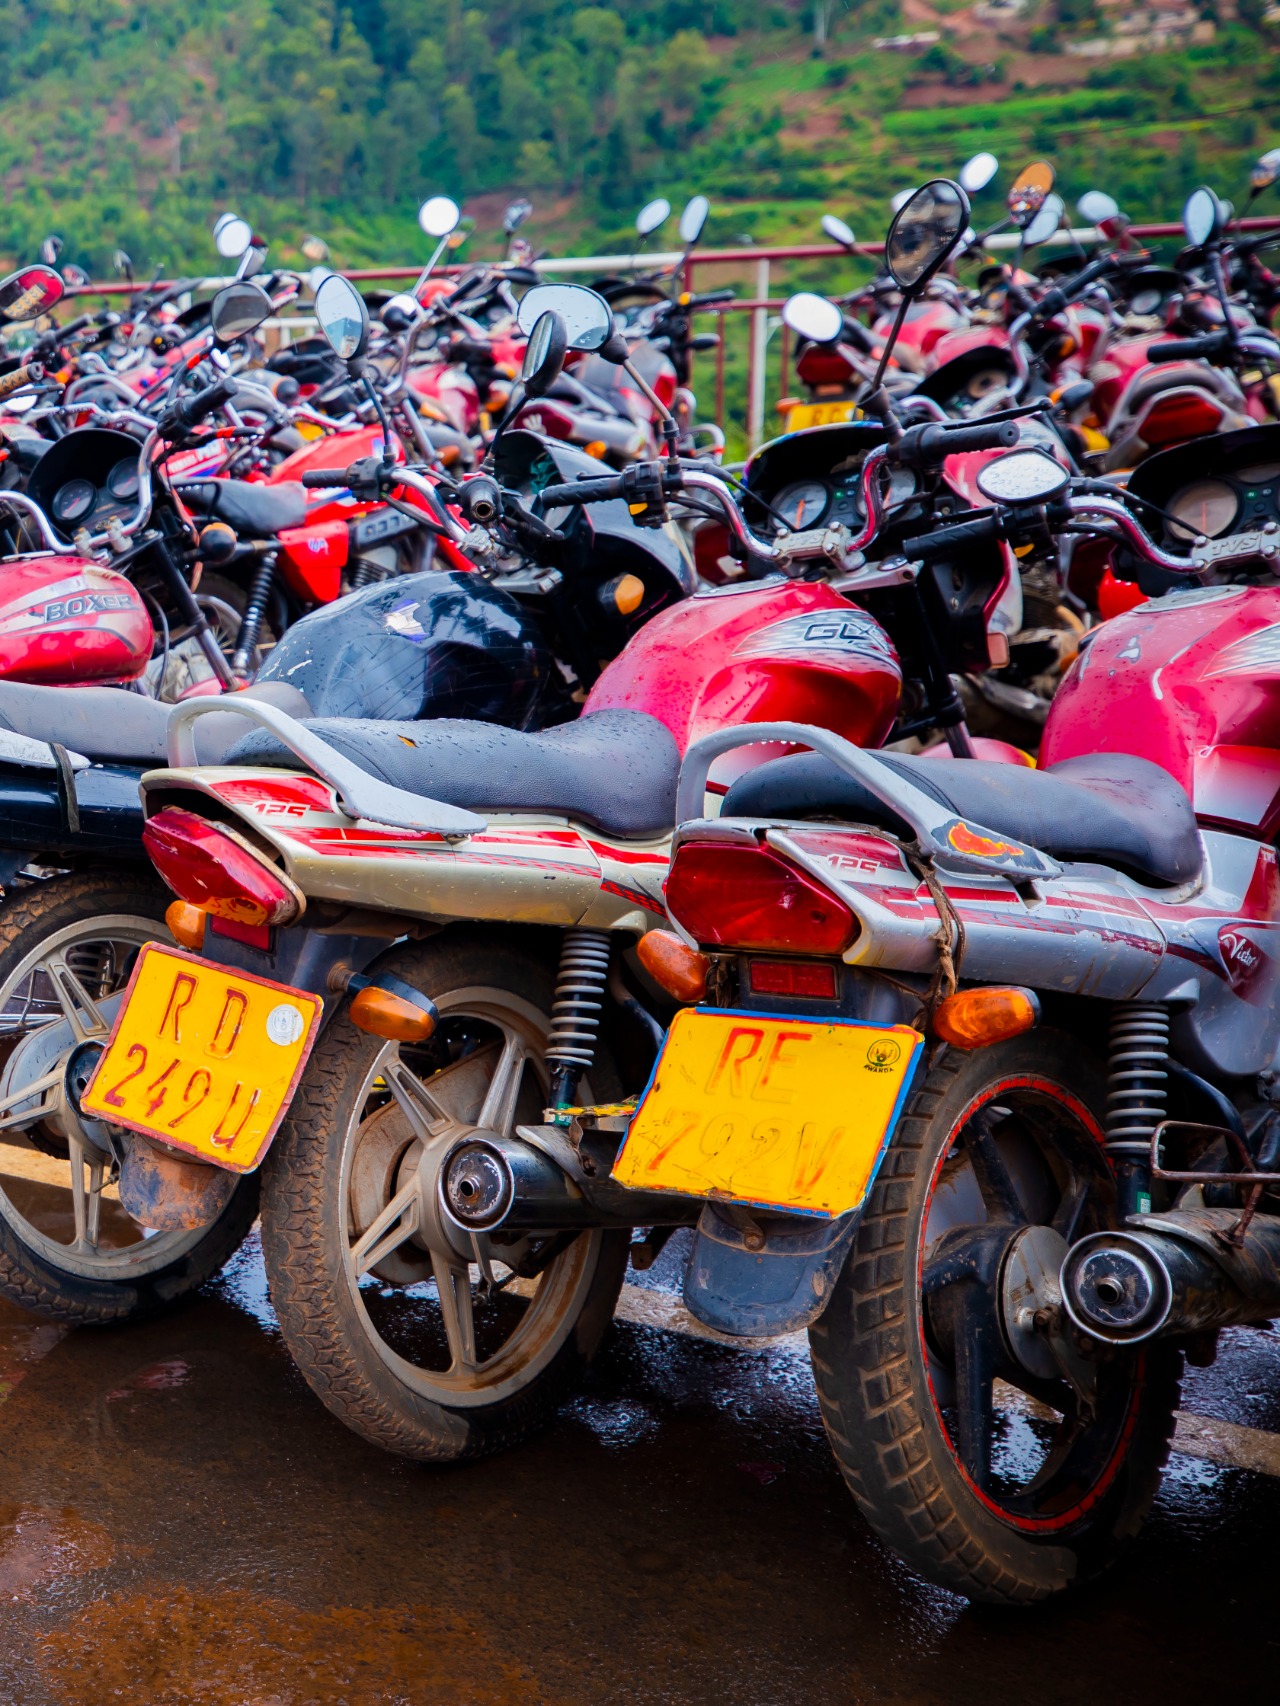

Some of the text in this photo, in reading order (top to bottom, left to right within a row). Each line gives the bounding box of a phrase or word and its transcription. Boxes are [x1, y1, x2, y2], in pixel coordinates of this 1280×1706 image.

[43, 594, 137, 623] BOXER
[803, 622, 891, 655] GLX
[254, 803, 310, 818] 125
[827, 854, 880, 874] 125
[1220, 933, 1258, 968] Victor
[863, 1063, 895, 1074] RWANDA
[103, 1042, 262, 1153] 249U
